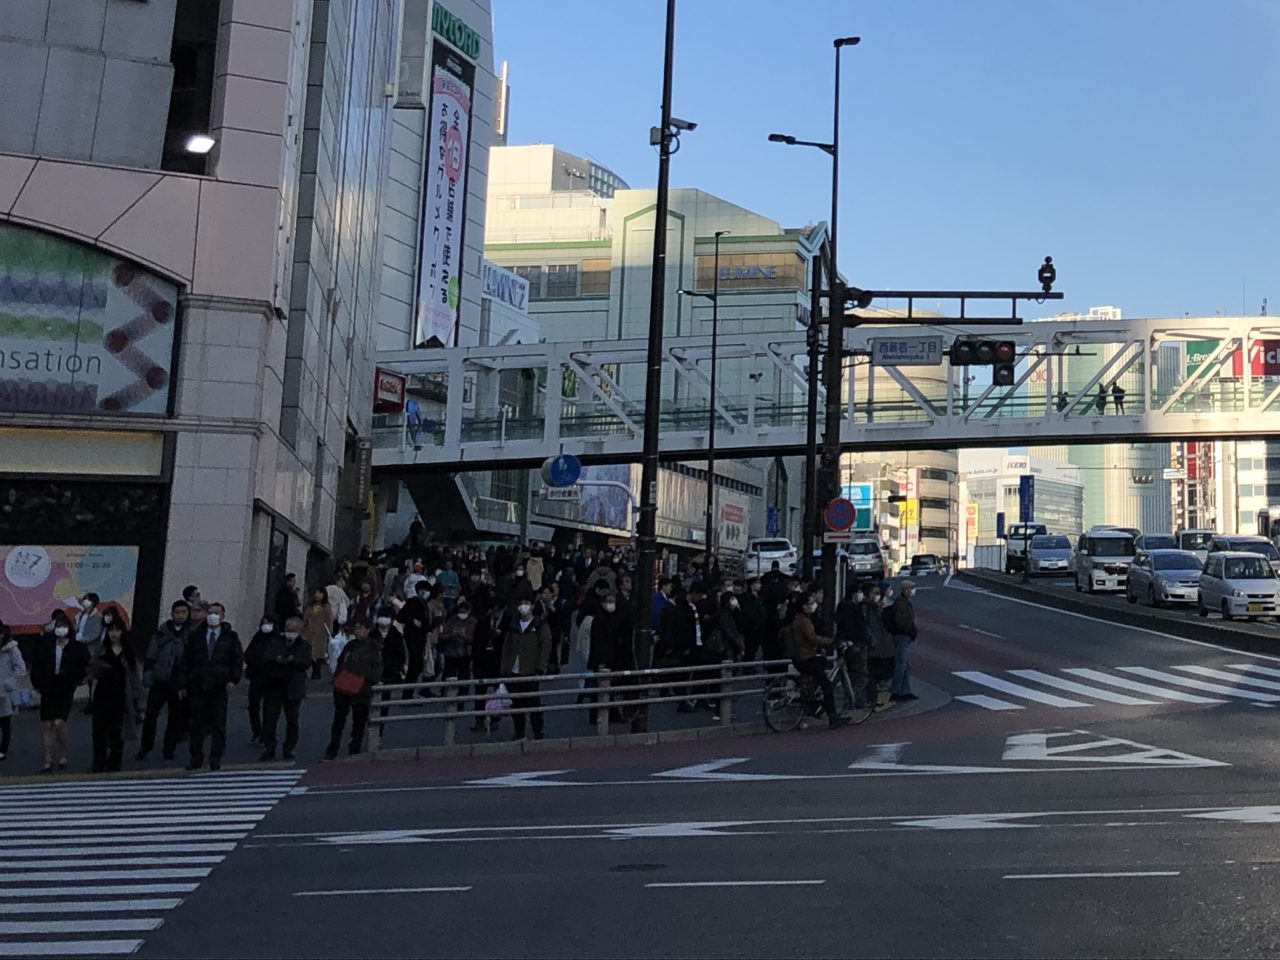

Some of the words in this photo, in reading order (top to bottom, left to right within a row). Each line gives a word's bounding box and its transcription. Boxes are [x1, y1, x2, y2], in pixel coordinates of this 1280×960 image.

[879, 341, 937, 353] 西新宿一丁目
[0, 347, 101, 374] sation
